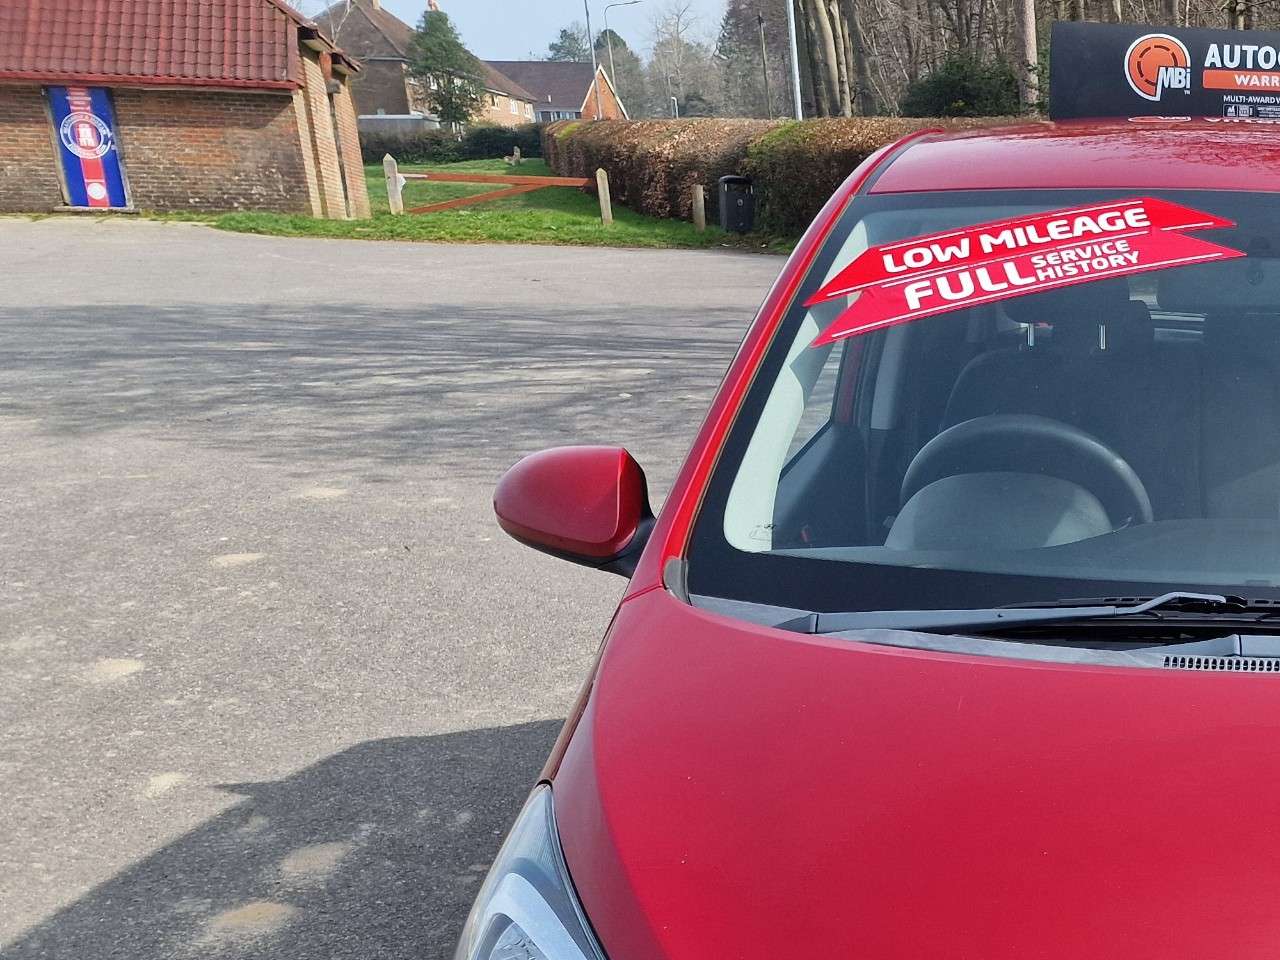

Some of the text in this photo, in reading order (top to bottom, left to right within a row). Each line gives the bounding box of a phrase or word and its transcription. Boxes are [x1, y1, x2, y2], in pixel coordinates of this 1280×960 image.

[1223, 95, 1276, 104] MULTI-AWARD
[882, 207, 1151, 273] LOW MILEAGE
[1031, 239, 1131, 267] SERVICE
[1039, 251, 1140, 282] HISTORY
[903, 259, 1036, 310] FULL
